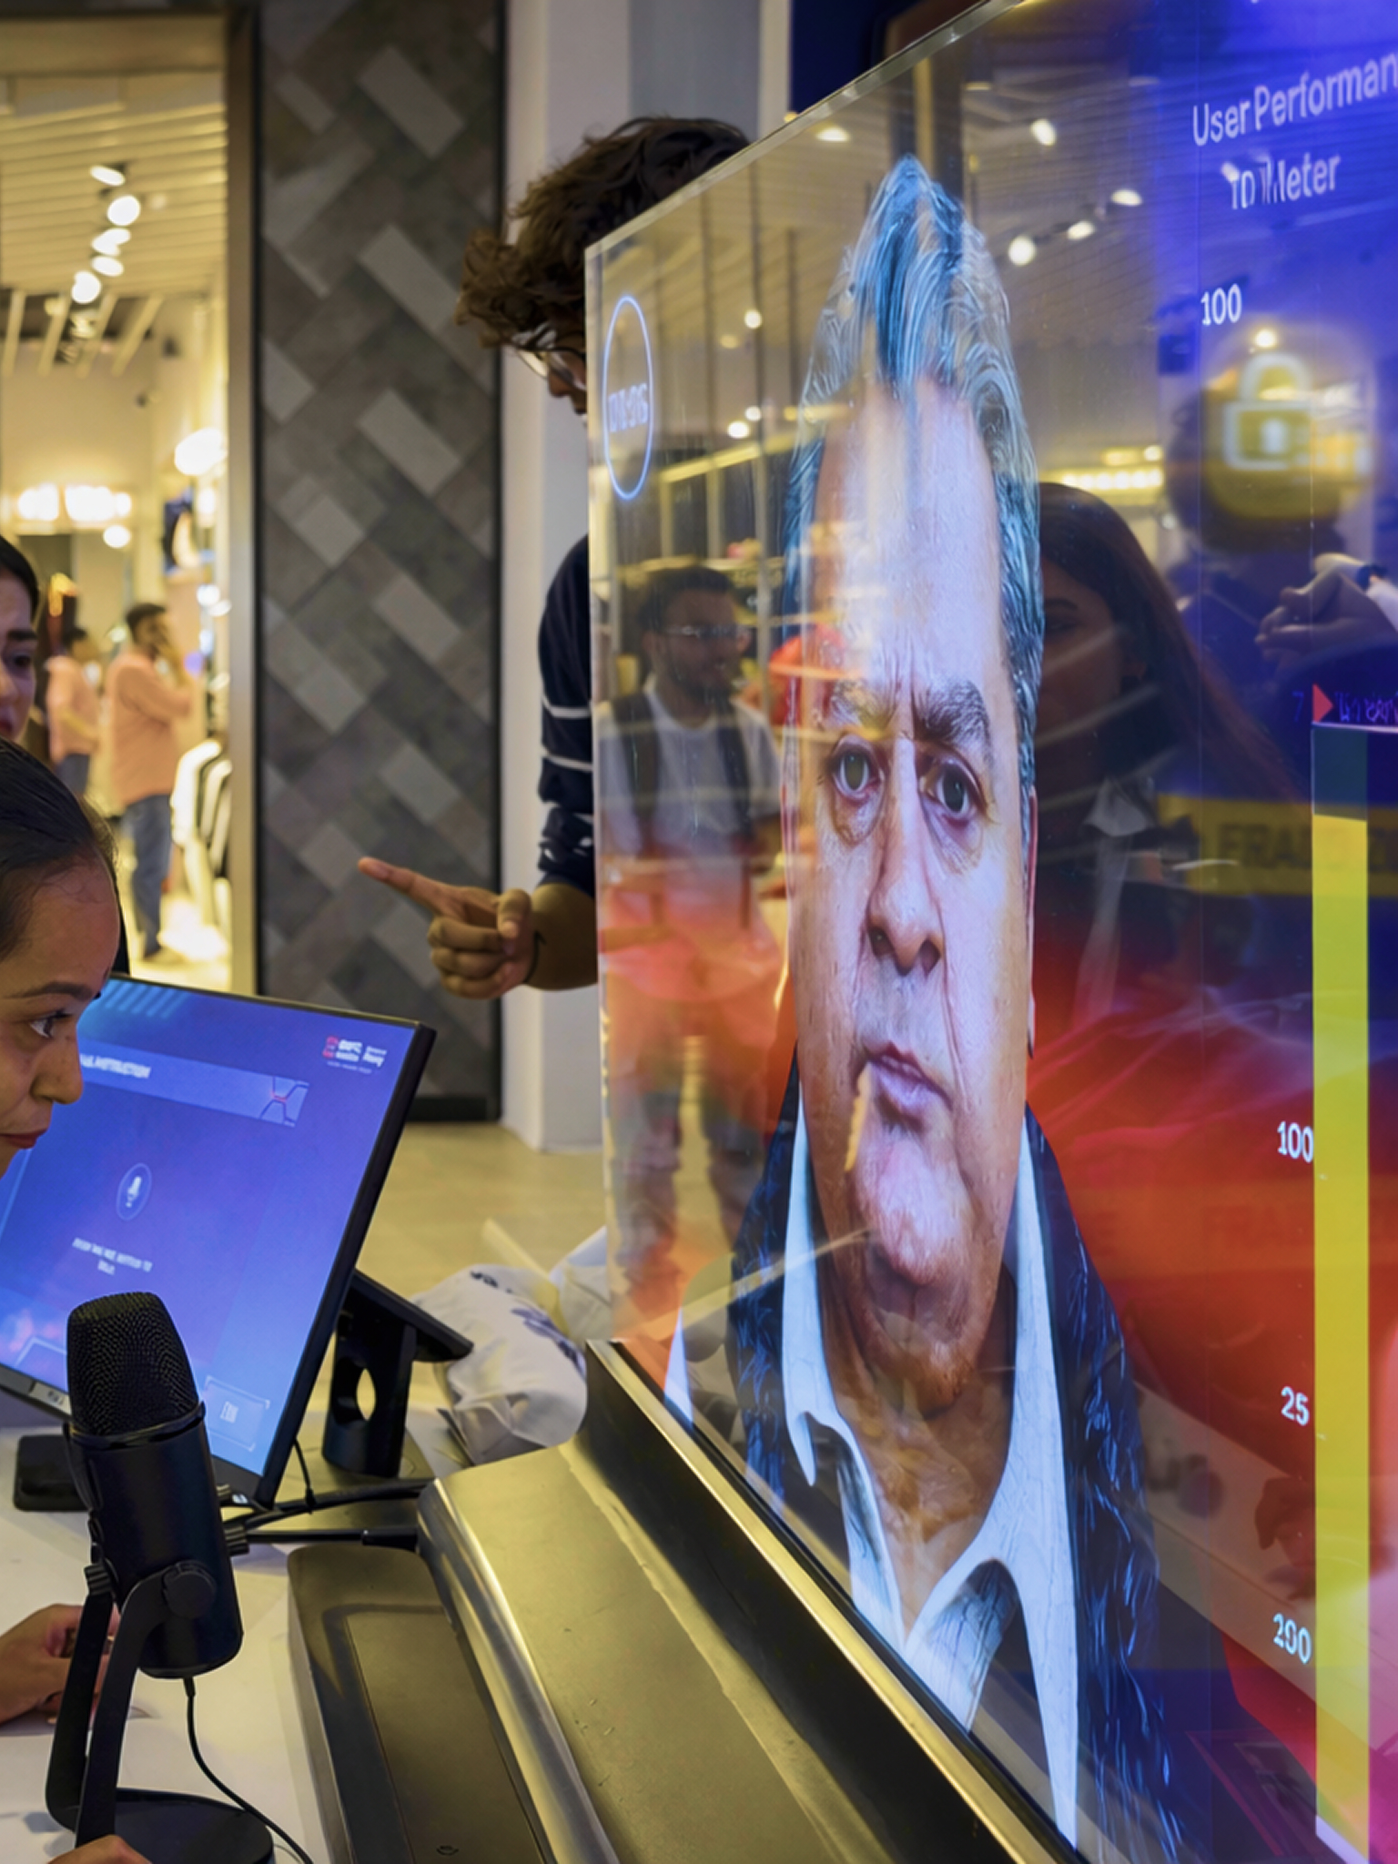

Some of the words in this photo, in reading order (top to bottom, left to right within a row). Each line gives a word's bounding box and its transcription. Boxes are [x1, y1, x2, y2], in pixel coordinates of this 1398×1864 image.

[1192, 101, 1250, 147] User
[1253, 51, 1398, 132] Performan
[1200, 283, 1242, 326] 100
[1277, 1120, 1315, 1163] 100
[1280, 1385, 1310, 1427] 25
